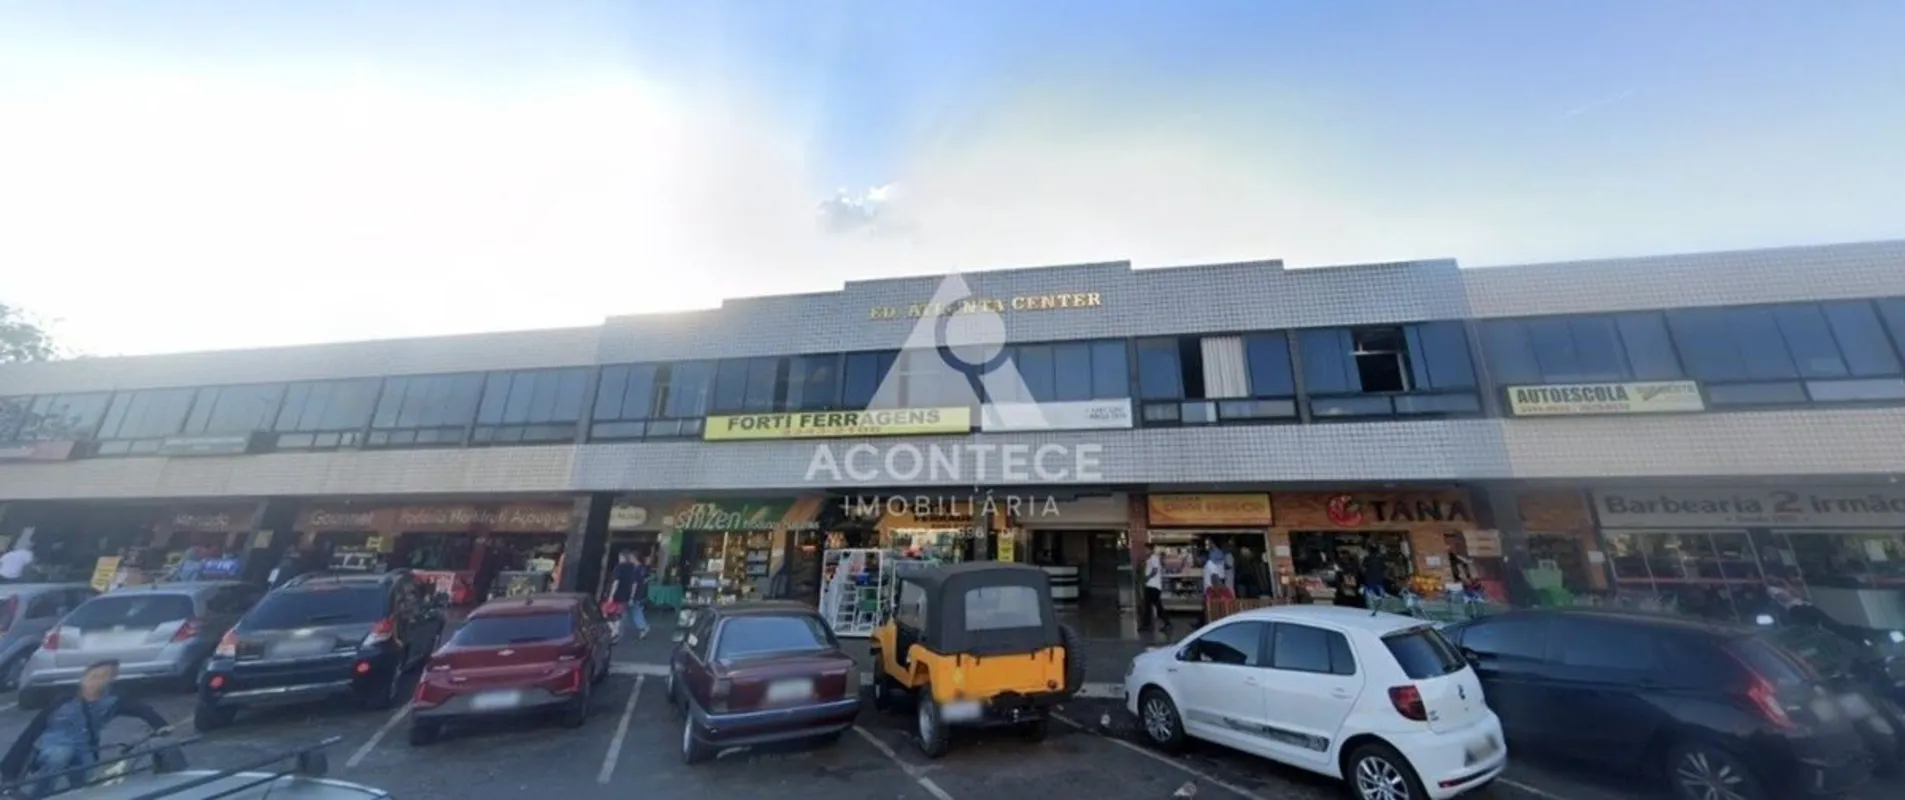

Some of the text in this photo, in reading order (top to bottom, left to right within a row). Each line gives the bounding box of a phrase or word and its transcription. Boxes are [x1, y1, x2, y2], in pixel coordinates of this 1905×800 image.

[1012, 292, 1101, 311] CENTER
[1516, 385, 1630, 404] AUTOESCOLA
[727, 415, 791, 431] FORTI
[800, 410, 940, 428] FERRAGENS
[1605, 495, 1764, 514] Barbearia
[1767, 490, 1802, 514] 2
